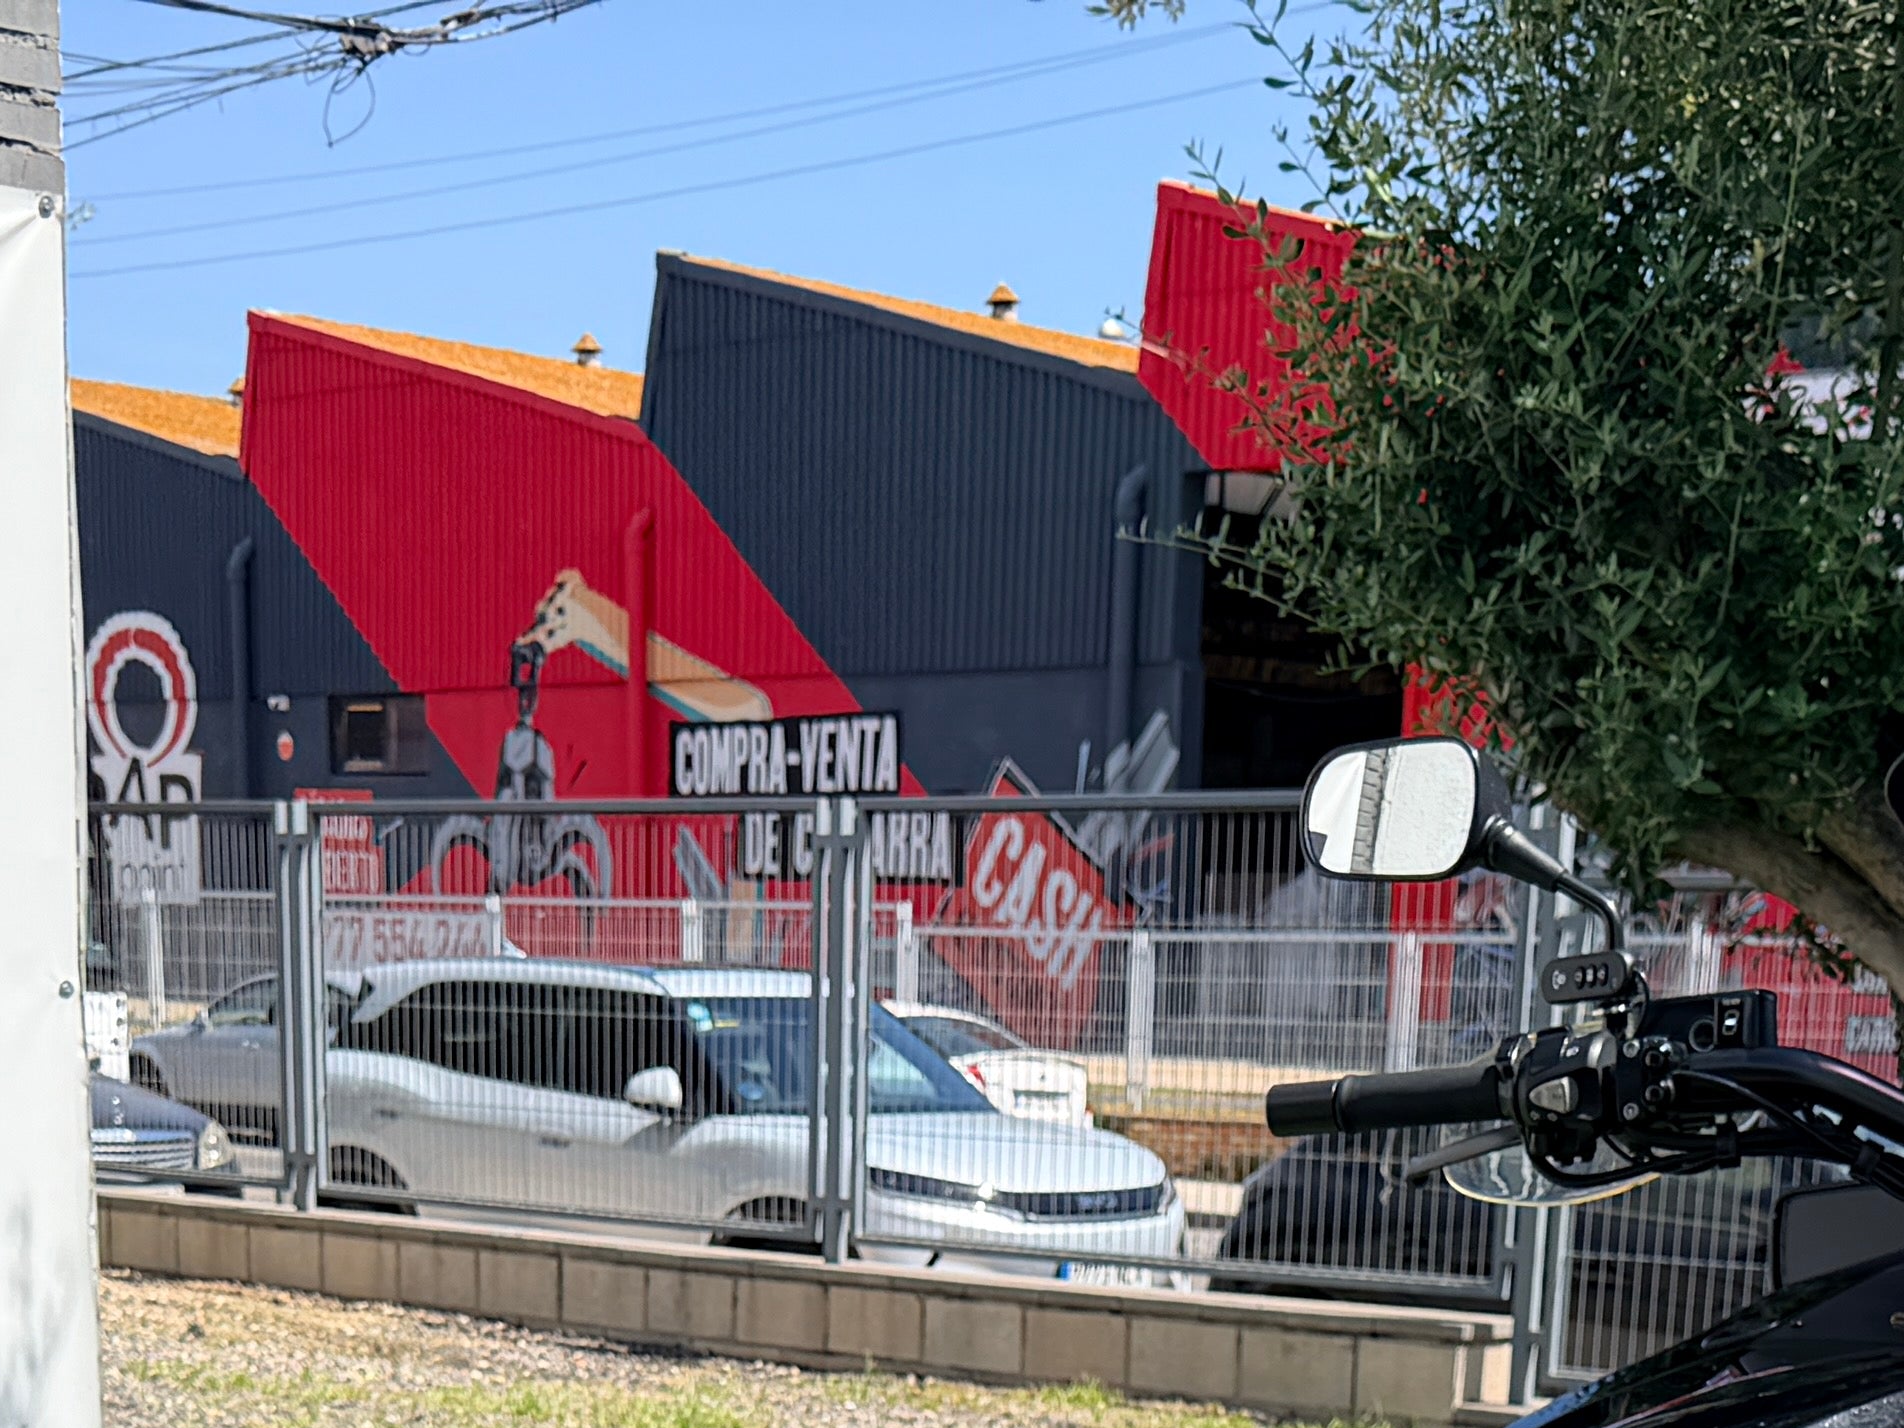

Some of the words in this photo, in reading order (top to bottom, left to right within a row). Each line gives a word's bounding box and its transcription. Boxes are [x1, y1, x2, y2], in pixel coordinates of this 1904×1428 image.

[674, 714, 897, 796] COMPRA-VENTA
[745, 812, 780, 876] DE
[793, 812, 952, 879] CARRA
[972, 816, 1104, 993] CASH
